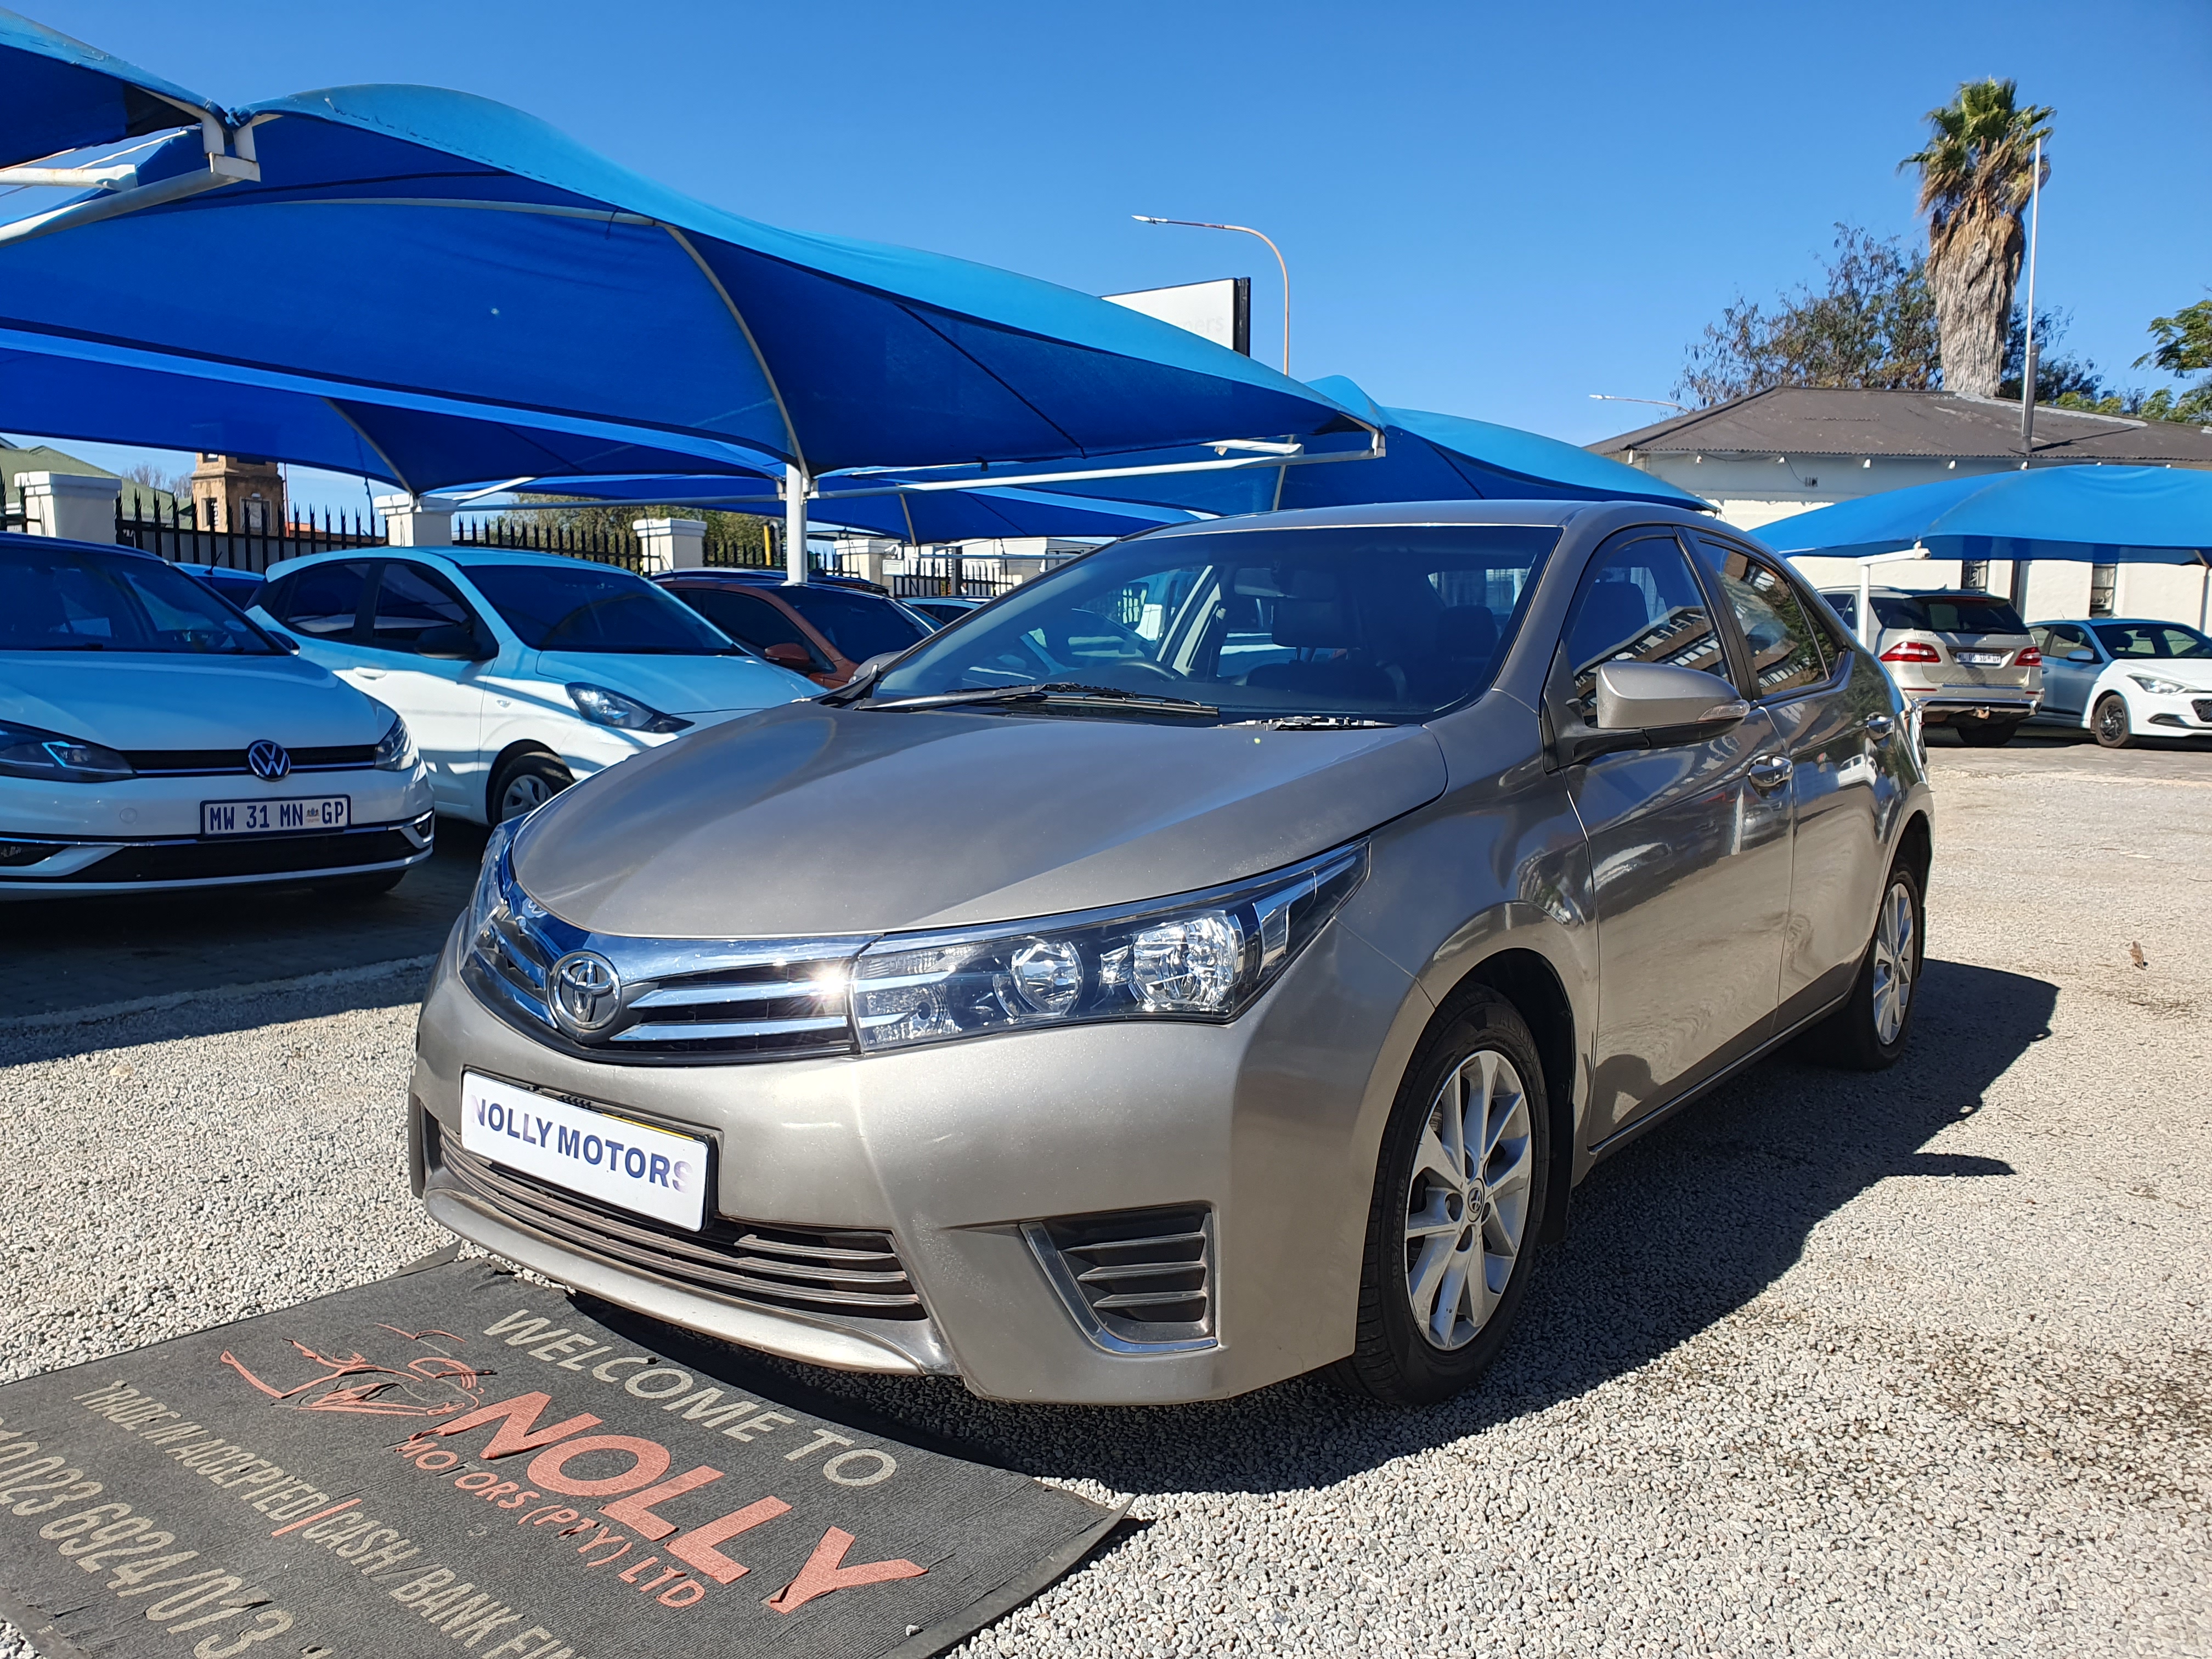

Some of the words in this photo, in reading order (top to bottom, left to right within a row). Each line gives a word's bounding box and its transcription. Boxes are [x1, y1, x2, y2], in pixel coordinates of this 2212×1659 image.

[210, 806, 235, 831] MW
[246, 805, 270, 829] 31
[280, 803, 303, 827] MN
[321, 801, 344, 825] GP
[471, 1094, 553, 1148] NOLLY
[558, 1125, 693, 1194] MOTORS
[72, 1379, 182, 1431] TRADE
[139, 1421, 210, 1446] IN
[483, 1309, 797, 1442] WELCOME
[783, 1428, 898, 1486] TO
[165, 1438, 330, 1521] ACCEPTED
[408, 1391, 929, 1614] NOLLY
[517, 1505, 633, 1567] (PTY)
[617, 1556, 706, 1608] LTD
